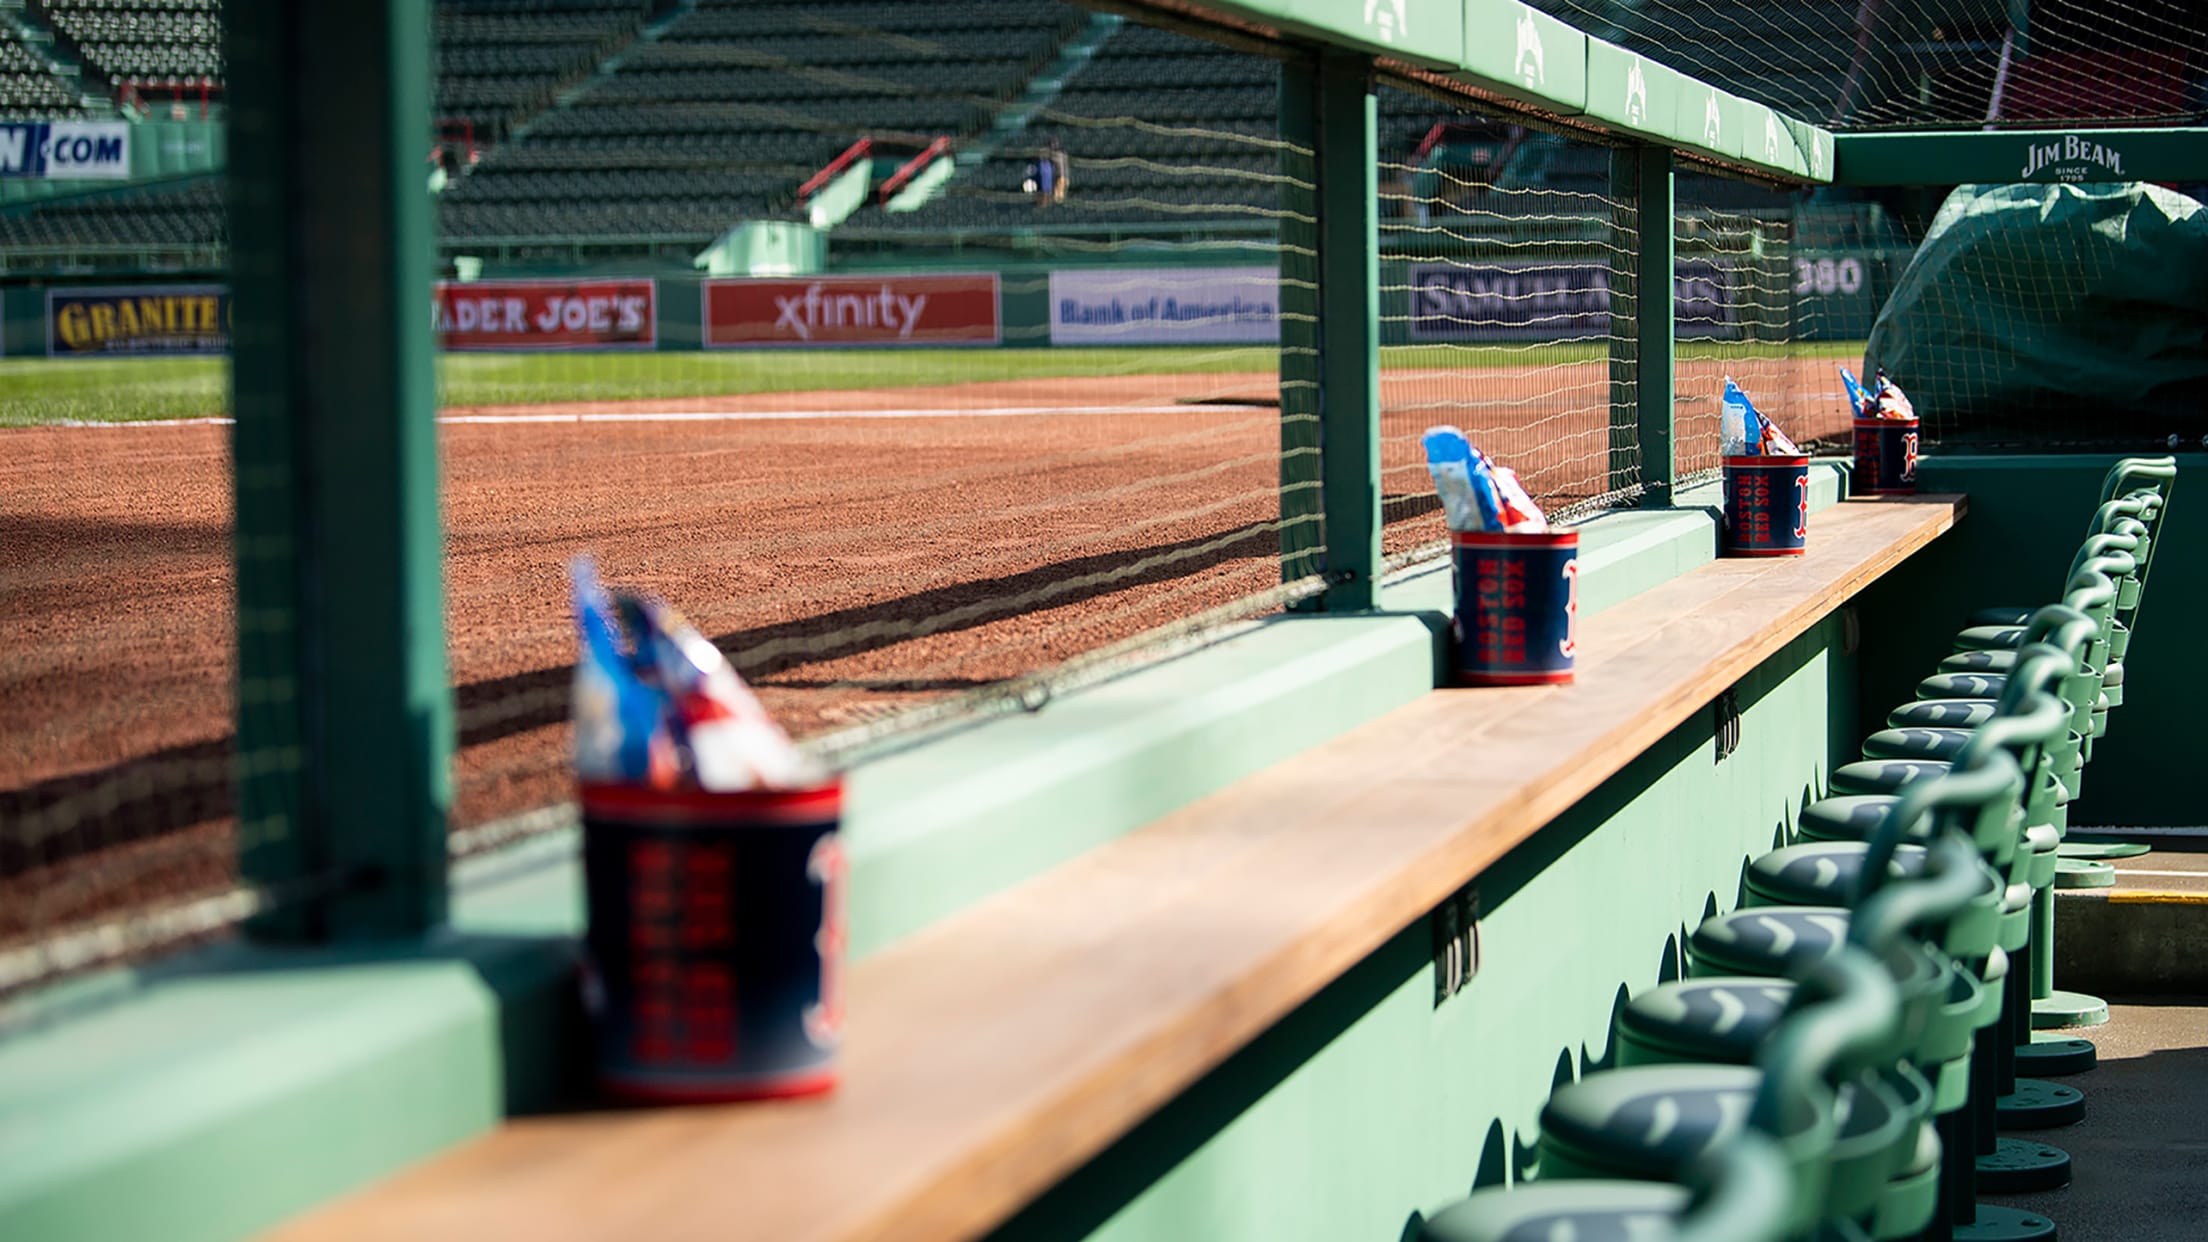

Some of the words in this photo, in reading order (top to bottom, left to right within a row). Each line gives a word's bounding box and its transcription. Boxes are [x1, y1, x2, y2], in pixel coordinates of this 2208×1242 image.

[2022, 144, 2060, 178] JIM
[2065, 135, 2121, 175] BEAM
[2056, 167, 2088, 175] SINCE
[58, 296, 219, 348] GRANITE
[536, 294, 645, 332] JOE'S
[774, 281, 927, 340] xfinity
[1060, 297, 1125, 324] Bank
[1130, 297, 1157, 320] of
[1738, 474, 1752, 543] BOSTON
[1755, 474, 1770, 506] SOX
[1755, 511, 1770, 543] RED
[1502, 559, 1526, 609] SOX
[1477, 558, 1500, 663] BOSTON
[1502, 616, 1526, 663] RED
